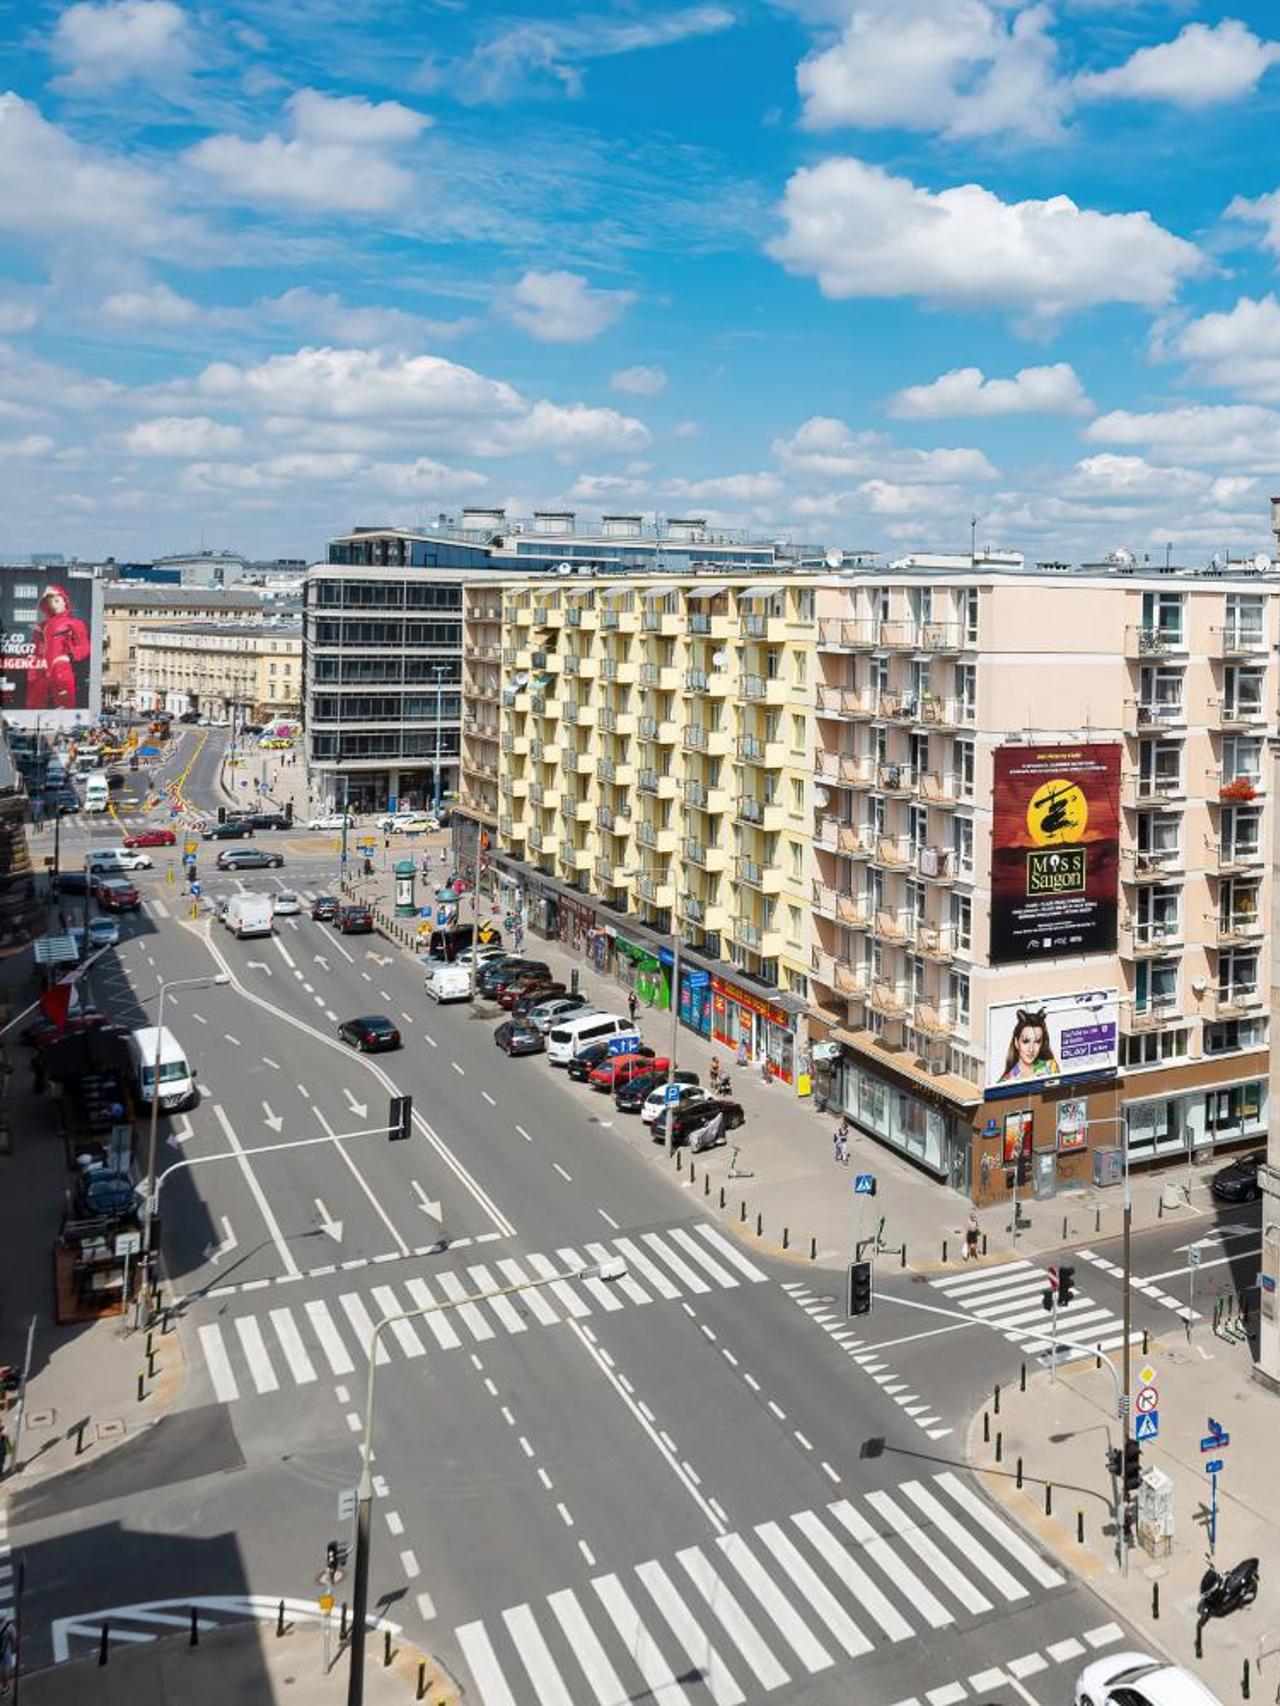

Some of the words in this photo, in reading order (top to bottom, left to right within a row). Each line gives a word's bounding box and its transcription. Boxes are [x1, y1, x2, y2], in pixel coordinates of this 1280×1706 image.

[10, 633, 25, 643] CO
[1031, 871, 1081, 892] Saigon
[1062, 1047, 1087, 1058] PLAY
[668, 1087, 678, 1099] P
